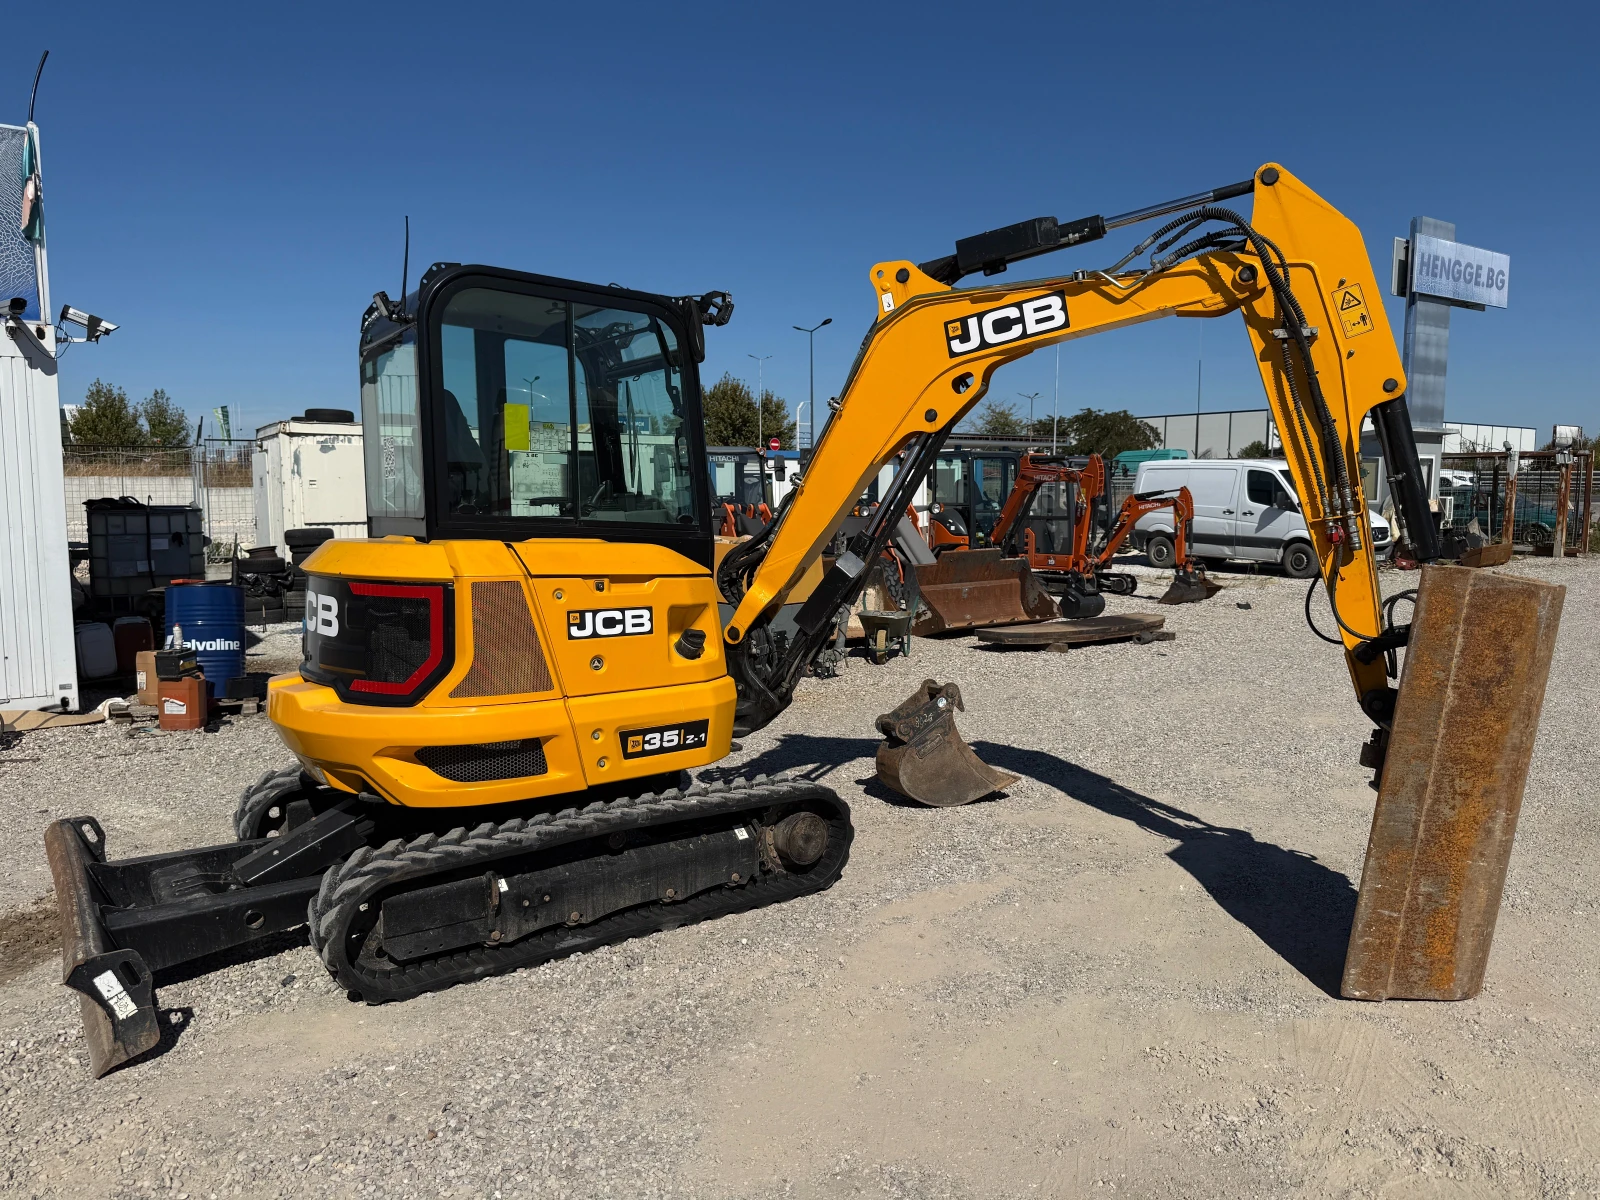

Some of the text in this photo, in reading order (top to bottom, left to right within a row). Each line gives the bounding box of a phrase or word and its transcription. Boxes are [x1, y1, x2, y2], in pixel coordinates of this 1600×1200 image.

[1420, 252, 1506, 291] HENGGE.BG
[949, 295, 1066, 353] JCB
[1033, 474, 1058, 482] HITACH
[305, 590, 339, 637] CB
[570, 609, 652, 637] JCB
[643, 729, 679, 751] 35
